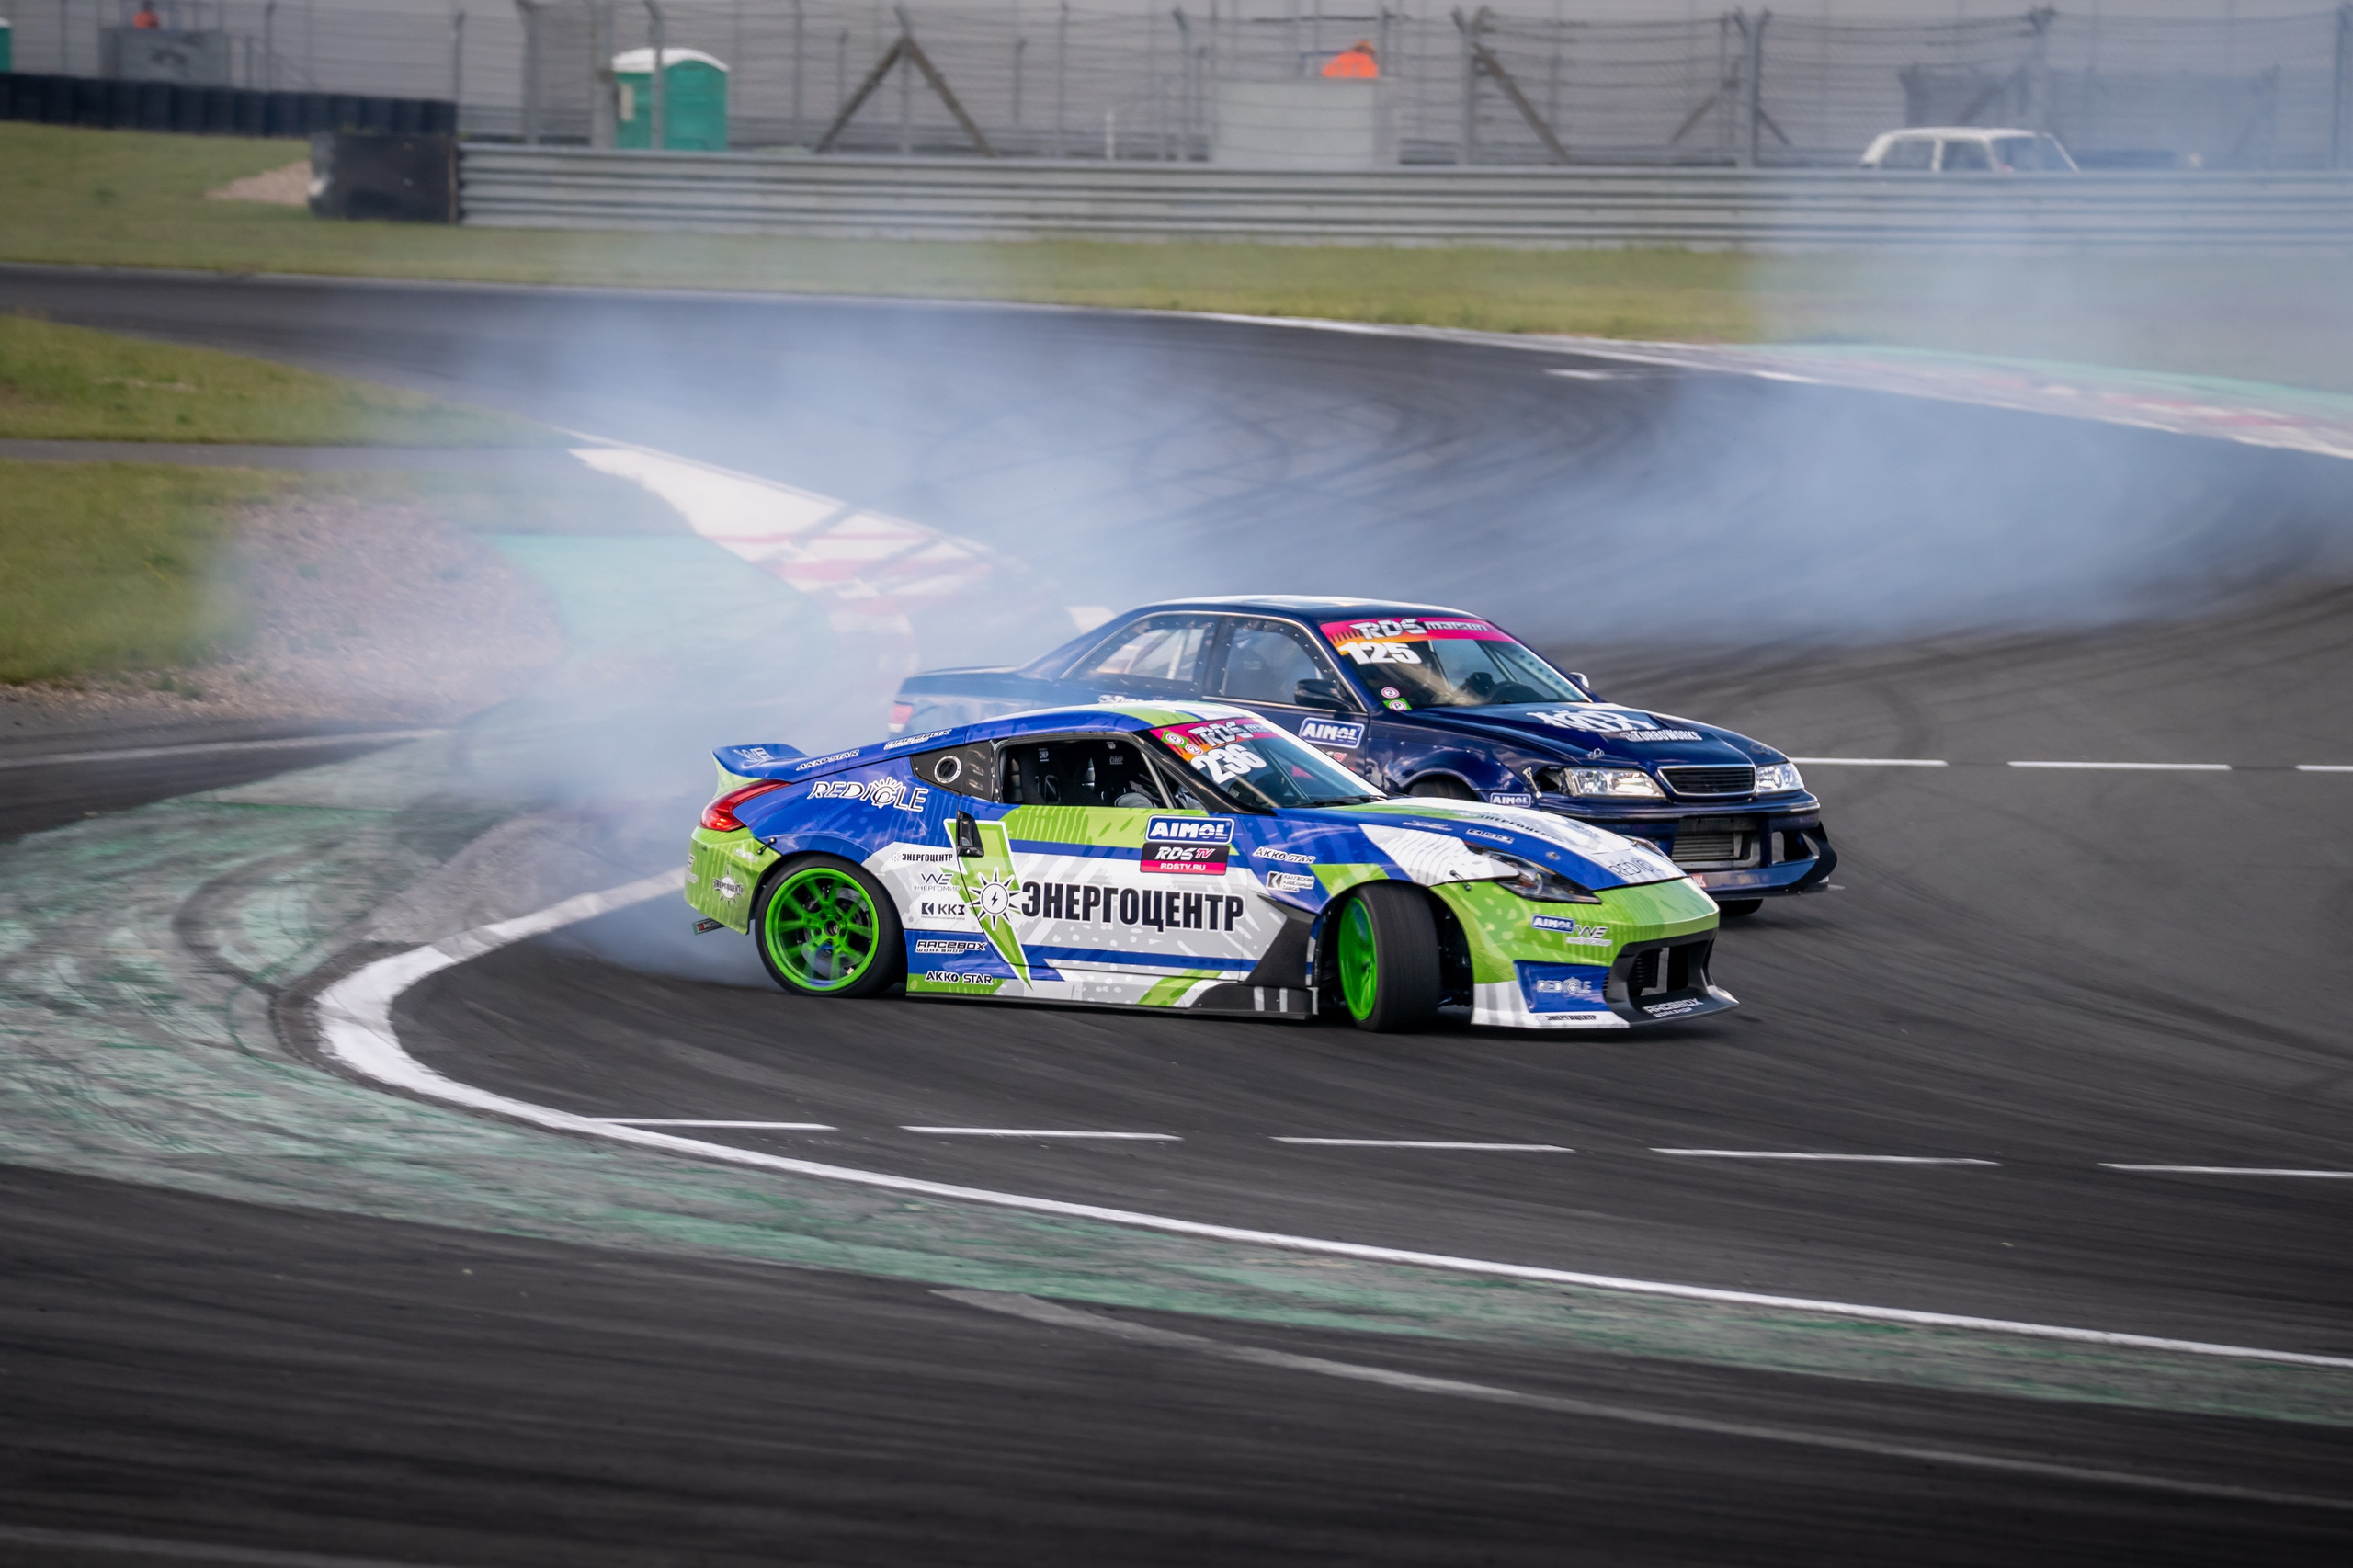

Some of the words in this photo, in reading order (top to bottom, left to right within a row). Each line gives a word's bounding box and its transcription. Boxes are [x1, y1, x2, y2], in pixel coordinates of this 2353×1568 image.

[1349, 618, 1427, 640] RDS
[1338, 642, 1422, 665] 125
[1302, 722, 1358, 743] AIMOL
[1190, 744, 1267, 784] 236
[1492, 796, 1529, 804] AIMOL
[1149, 822, 1229, 839] AIMOL
[902, 853, 953, 862] ЭНЕРГОЦЕНТР
[1154, 846, 1197, 860] RDS
[1255, 848, 1286, 860] AKKO
[1287, 854, 1315, 863] STAR
[1160, 862, 1206, 870] RDSTV.RU
[1021, 881, 1244, 933] ЭНЕРГОЦЕНТР
[926, 971, 959, 983] AKKO
[963, 974, 993, 984] STAR
